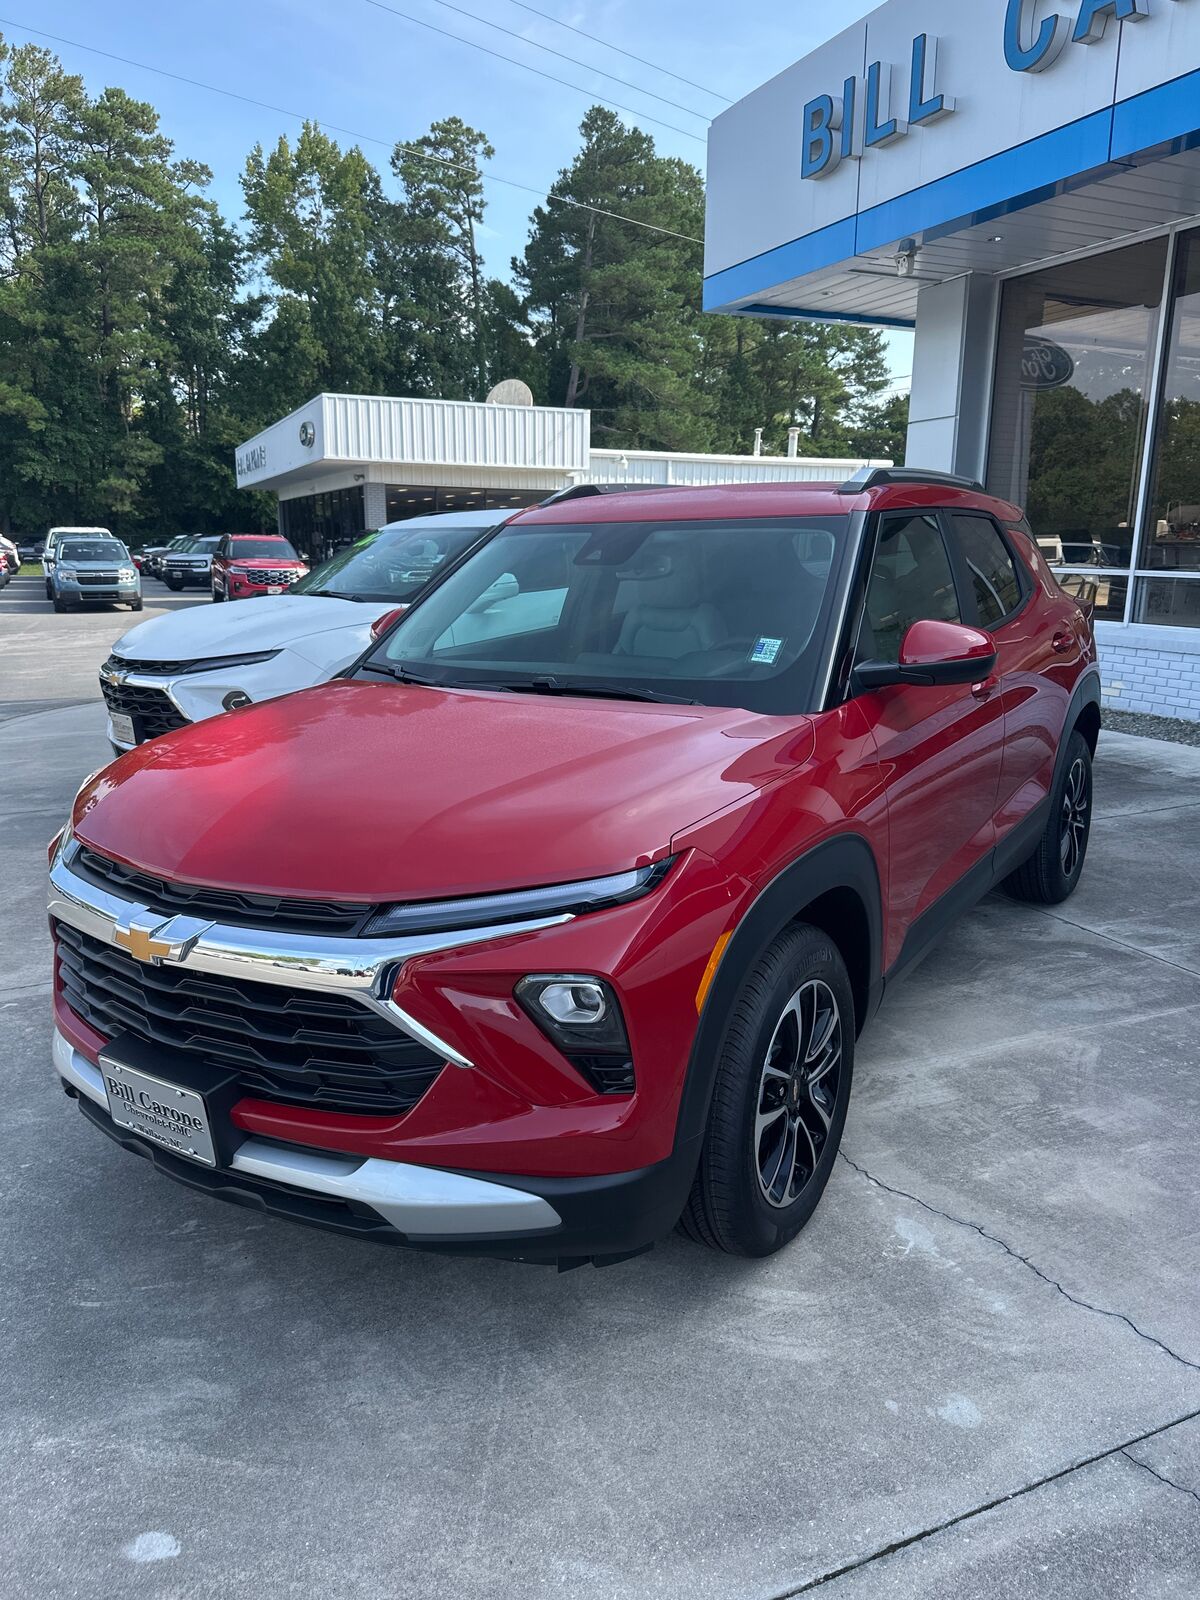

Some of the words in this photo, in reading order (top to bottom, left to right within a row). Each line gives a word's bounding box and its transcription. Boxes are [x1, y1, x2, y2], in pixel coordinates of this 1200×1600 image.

[801, 33, 955, 180] BILL
[107, 1076, 135, 1102] Bill
[139, 1091, 203, 1131] Carone
